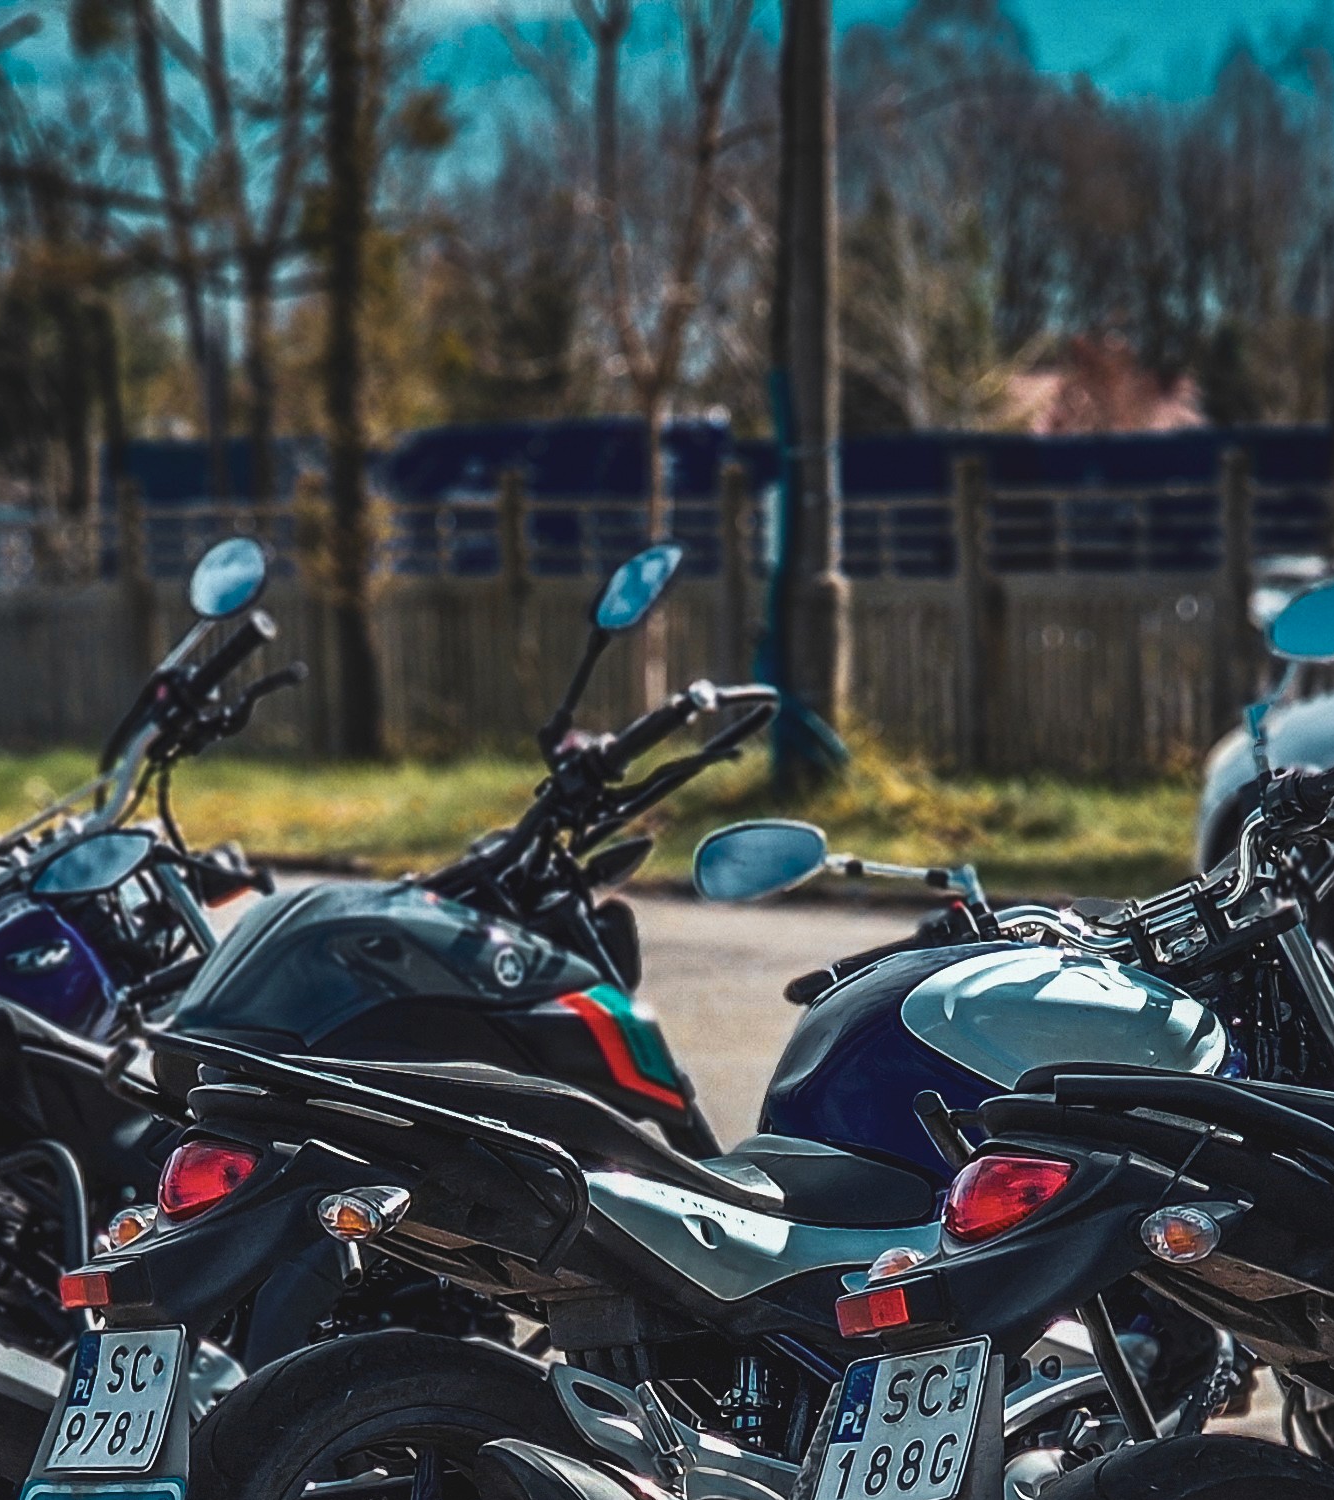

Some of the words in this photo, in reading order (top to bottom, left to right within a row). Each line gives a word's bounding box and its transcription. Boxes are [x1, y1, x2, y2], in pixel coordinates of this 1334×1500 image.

[73, 1379, 89, 1399] PL
[107, 1345, 152, 1393] SC
[882, 1365, 949, 1424] SC
[58, 1411, 155, 1455] 978J
[838, 1412, 863, 1435] PL
[836, 1433, 958, 1500] 188G
